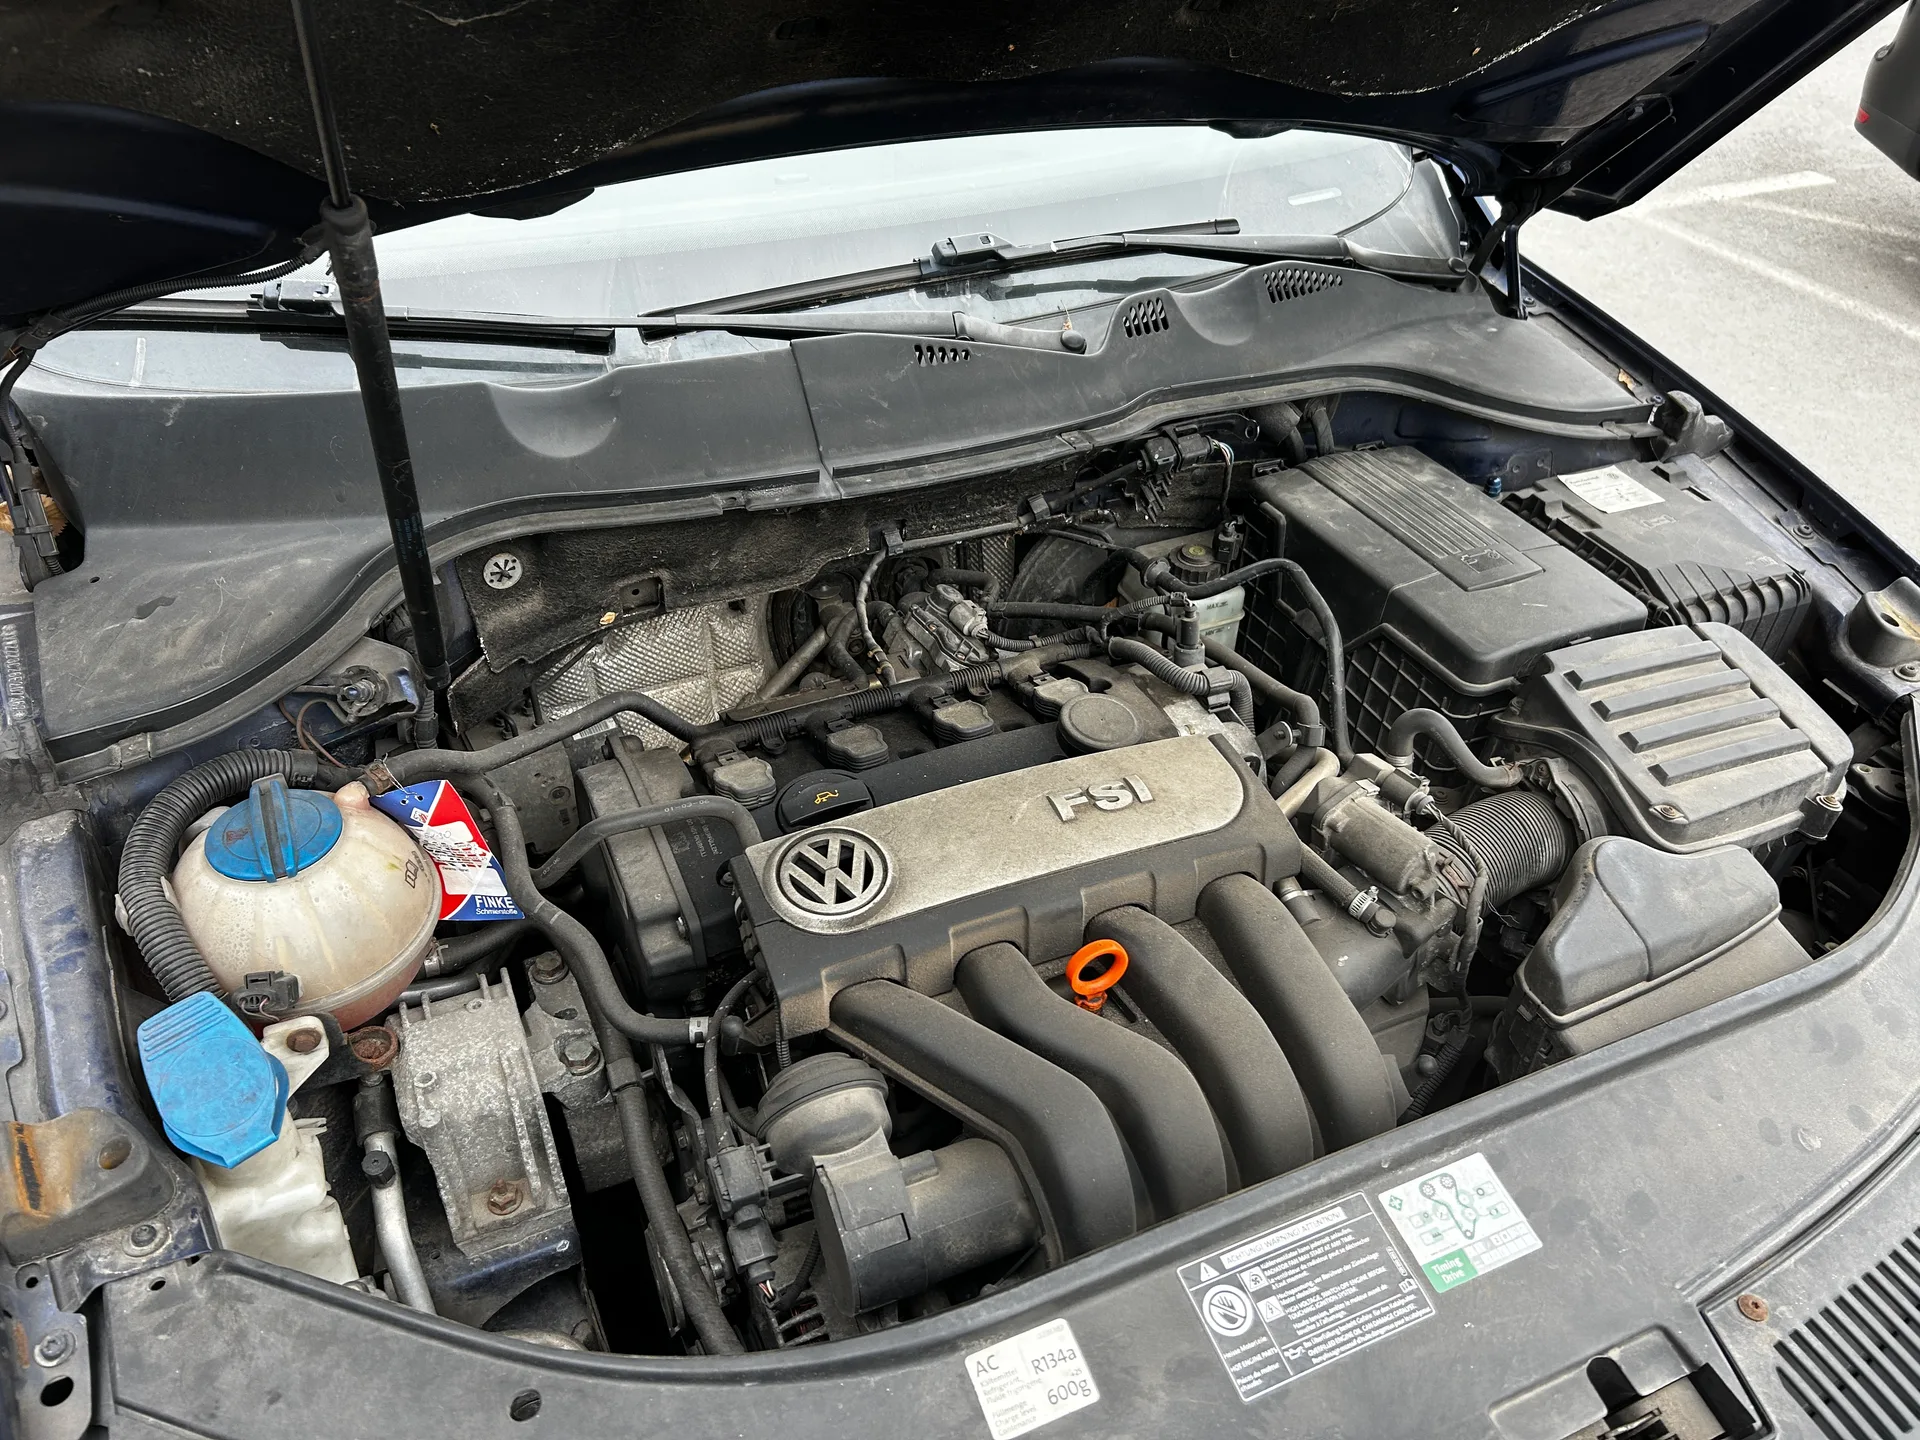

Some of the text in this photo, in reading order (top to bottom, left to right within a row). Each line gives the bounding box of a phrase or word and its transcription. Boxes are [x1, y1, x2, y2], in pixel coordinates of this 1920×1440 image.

[1046, 774, 1153, 822] FSI
[781, 831, 882, 910] VW
[475, 895, 515, 908] FINKE
[1432, 1258, 1463, 1275] Timing
[1442, 1270, 1465, 1284] Drive
[977, 1354, 999, 1377] AC
[1031, 1349, 1077, 1374] R134a
[1048, 1379, 1091, 1405] 600g
